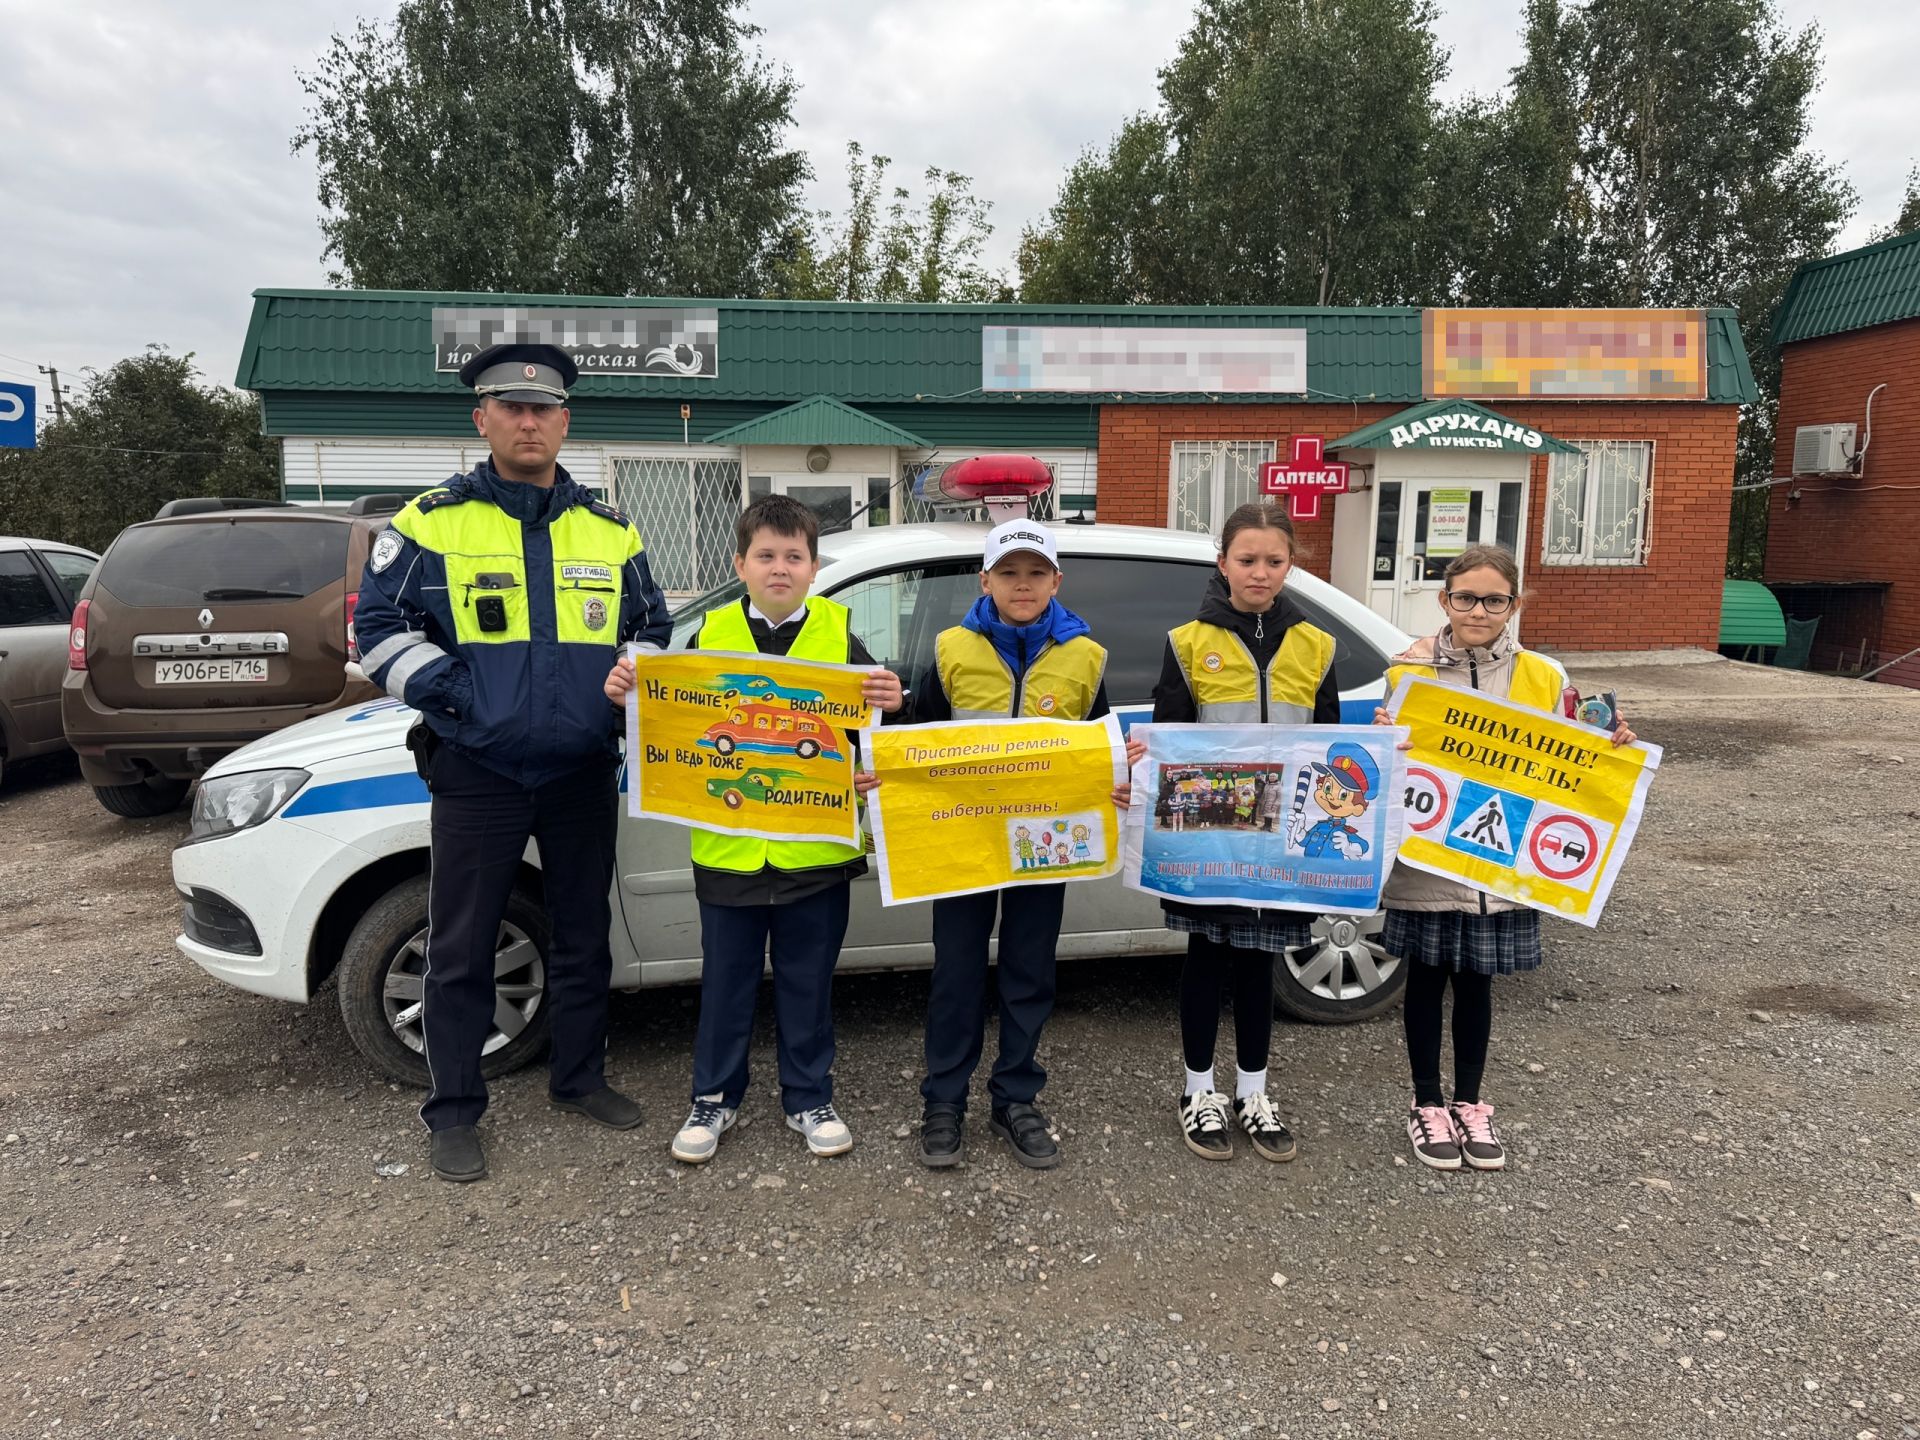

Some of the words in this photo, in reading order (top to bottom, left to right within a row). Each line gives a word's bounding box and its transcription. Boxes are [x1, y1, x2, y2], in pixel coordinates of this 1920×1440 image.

[1389, 413, 1543, 449] ДАРУХАНӘ
[1429, 435, 1503, 449] ПУНКТЫ
[1274, 471, 1338, 485] АПТЕКА
[999, 531, 1044, 544] EXEED
[564, 567, 583, 576] ДПС
[584, 567, 611, 577] ГИБДД
[137, 642, 277, 653] DUSTER
[234, 660, 261, 674] 716
[1442, 707, 1600, 769] ВНИМАНИЕ!
[905, 743, 1000, 763] Пристегни
[1005, 737, 1070, 754] ремень
[928, 760, 1051, 778] безопасности
[1439, 735, 1582, 793] ВОДИТЕЛЬ!
[931, 803, 994, 821] выбери
[998, 801, 1059, 814] жизнь!
[1157, 861, 1200, 876] ЮНЫЕ
[1203, 862, 1293, 882] ИНСПЕКТОРЫ
[1295, 871, 1374, 889] ДВИЖЕНИЯ
